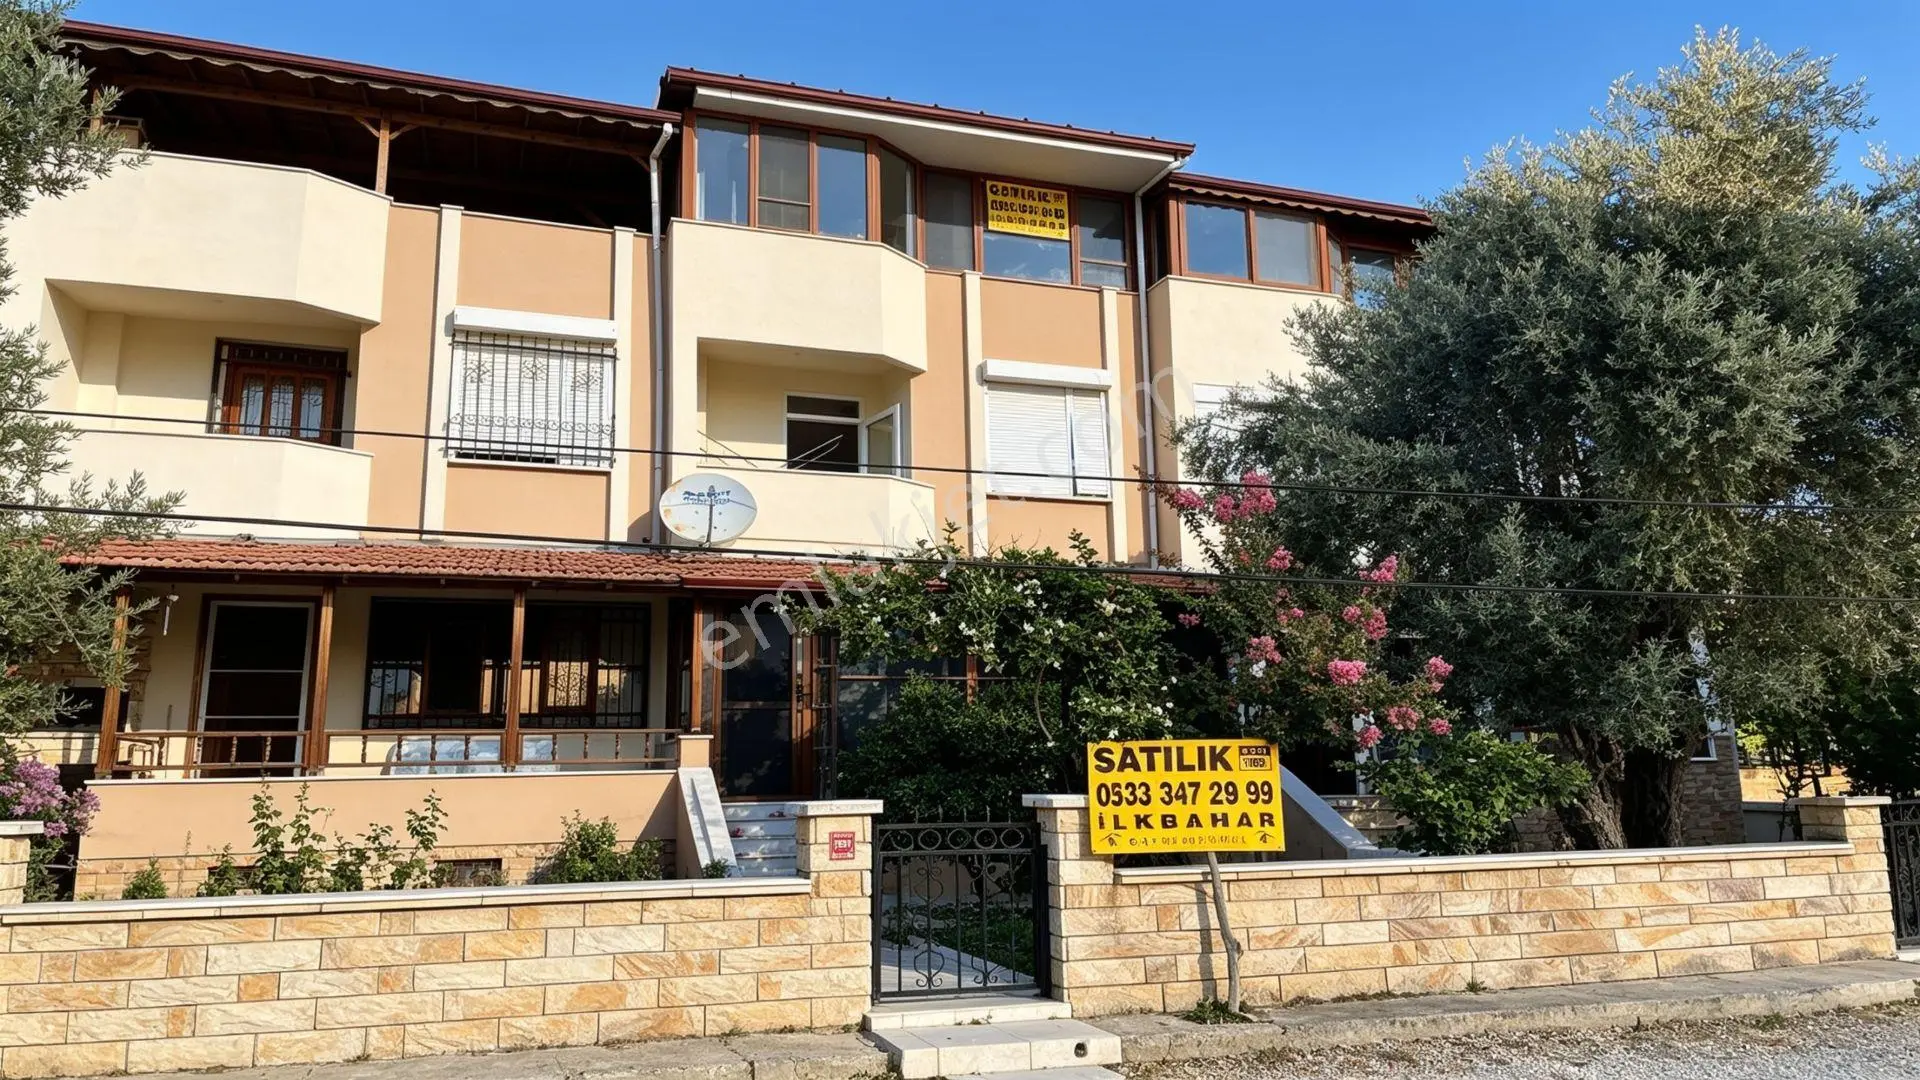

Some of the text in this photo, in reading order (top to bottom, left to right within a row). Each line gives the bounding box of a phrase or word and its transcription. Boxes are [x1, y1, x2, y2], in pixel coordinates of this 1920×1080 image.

[1094, 745, 1234, 773] SATILIK
[1096, 781, 1273, 807] 0533 347 29 99
